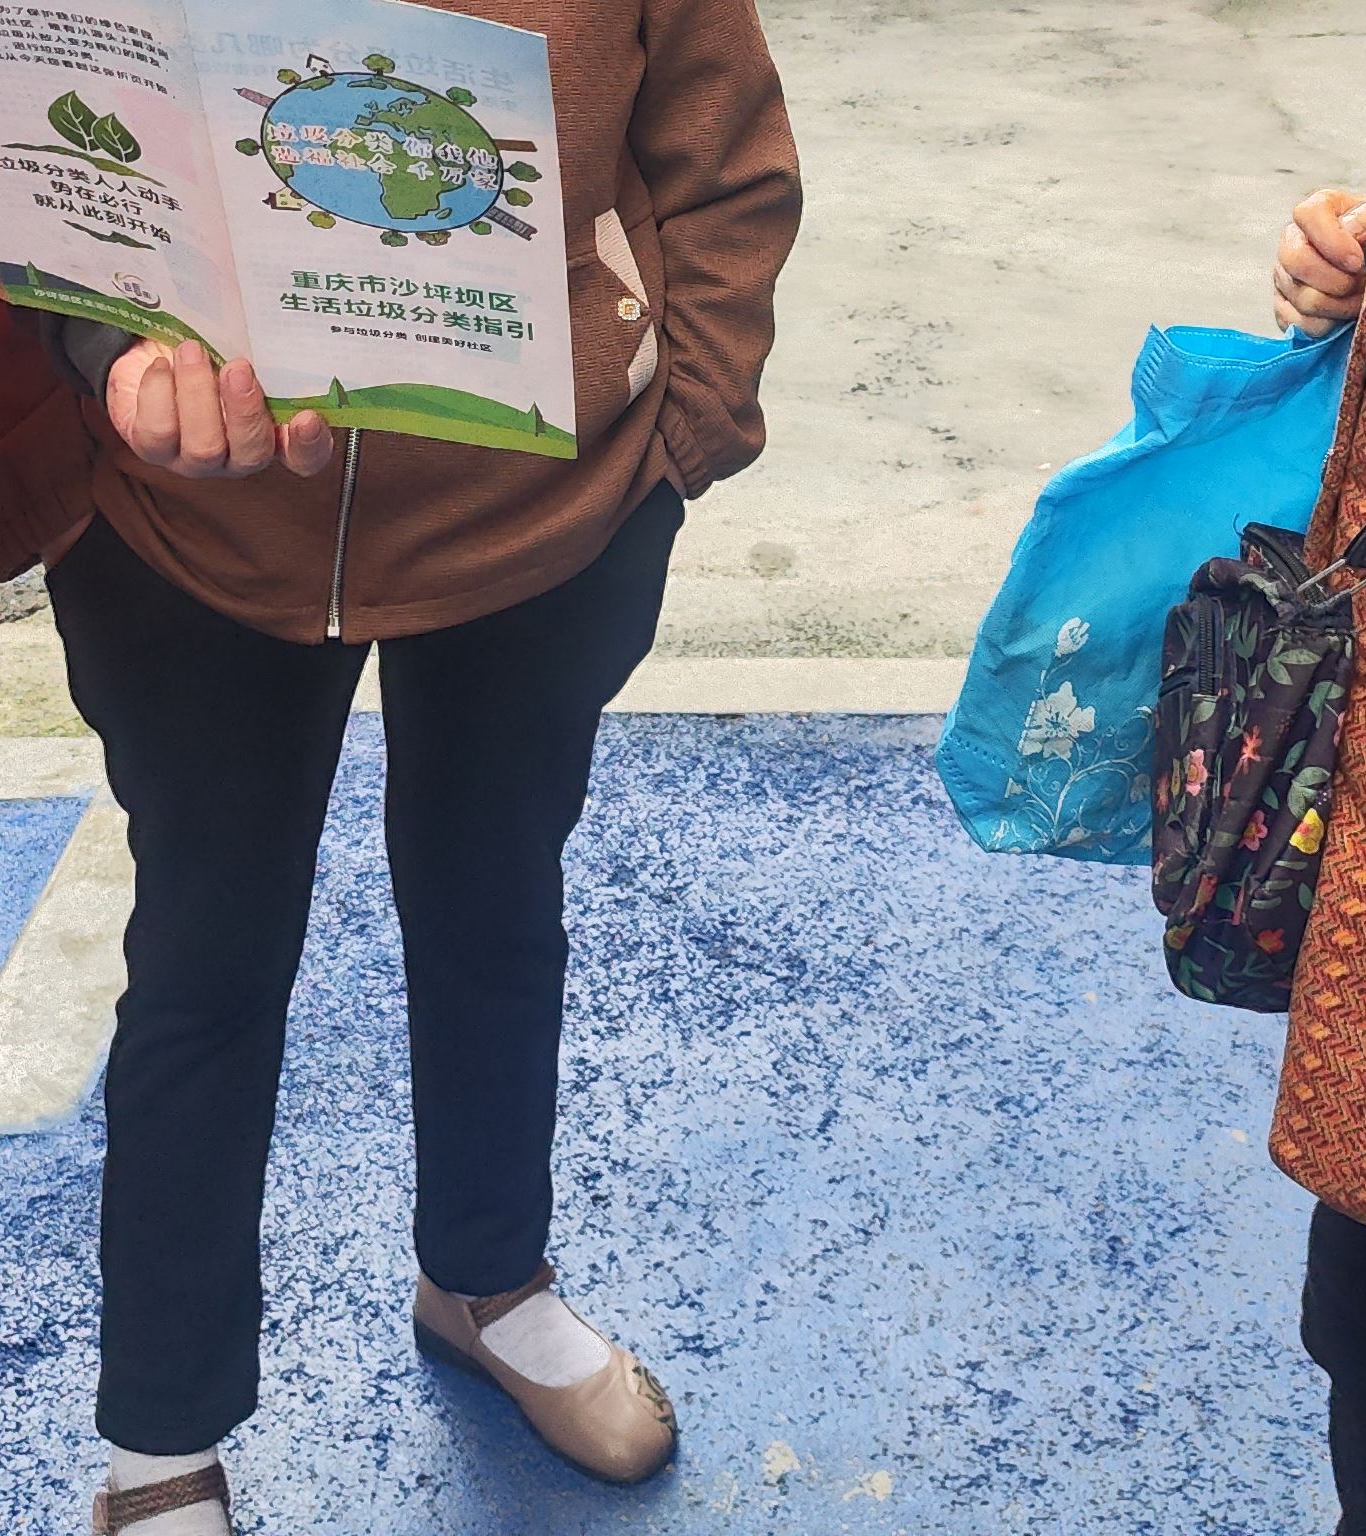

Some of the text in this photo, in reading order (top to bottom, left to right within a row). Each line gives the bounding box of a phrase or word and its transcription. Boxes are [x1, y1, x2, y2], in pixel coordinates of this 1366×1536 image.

[32, 193, 172, 244] 就从此刻开始
[50, 179, 143, 215] 势在必行
[290, 269, 519, 314] 重庆市沙坪坝区
[279, 293, 534, 341] 生活垃圾分类指引
[330, 325, 493, 353] 参与垃圾分类 创建美好社区
